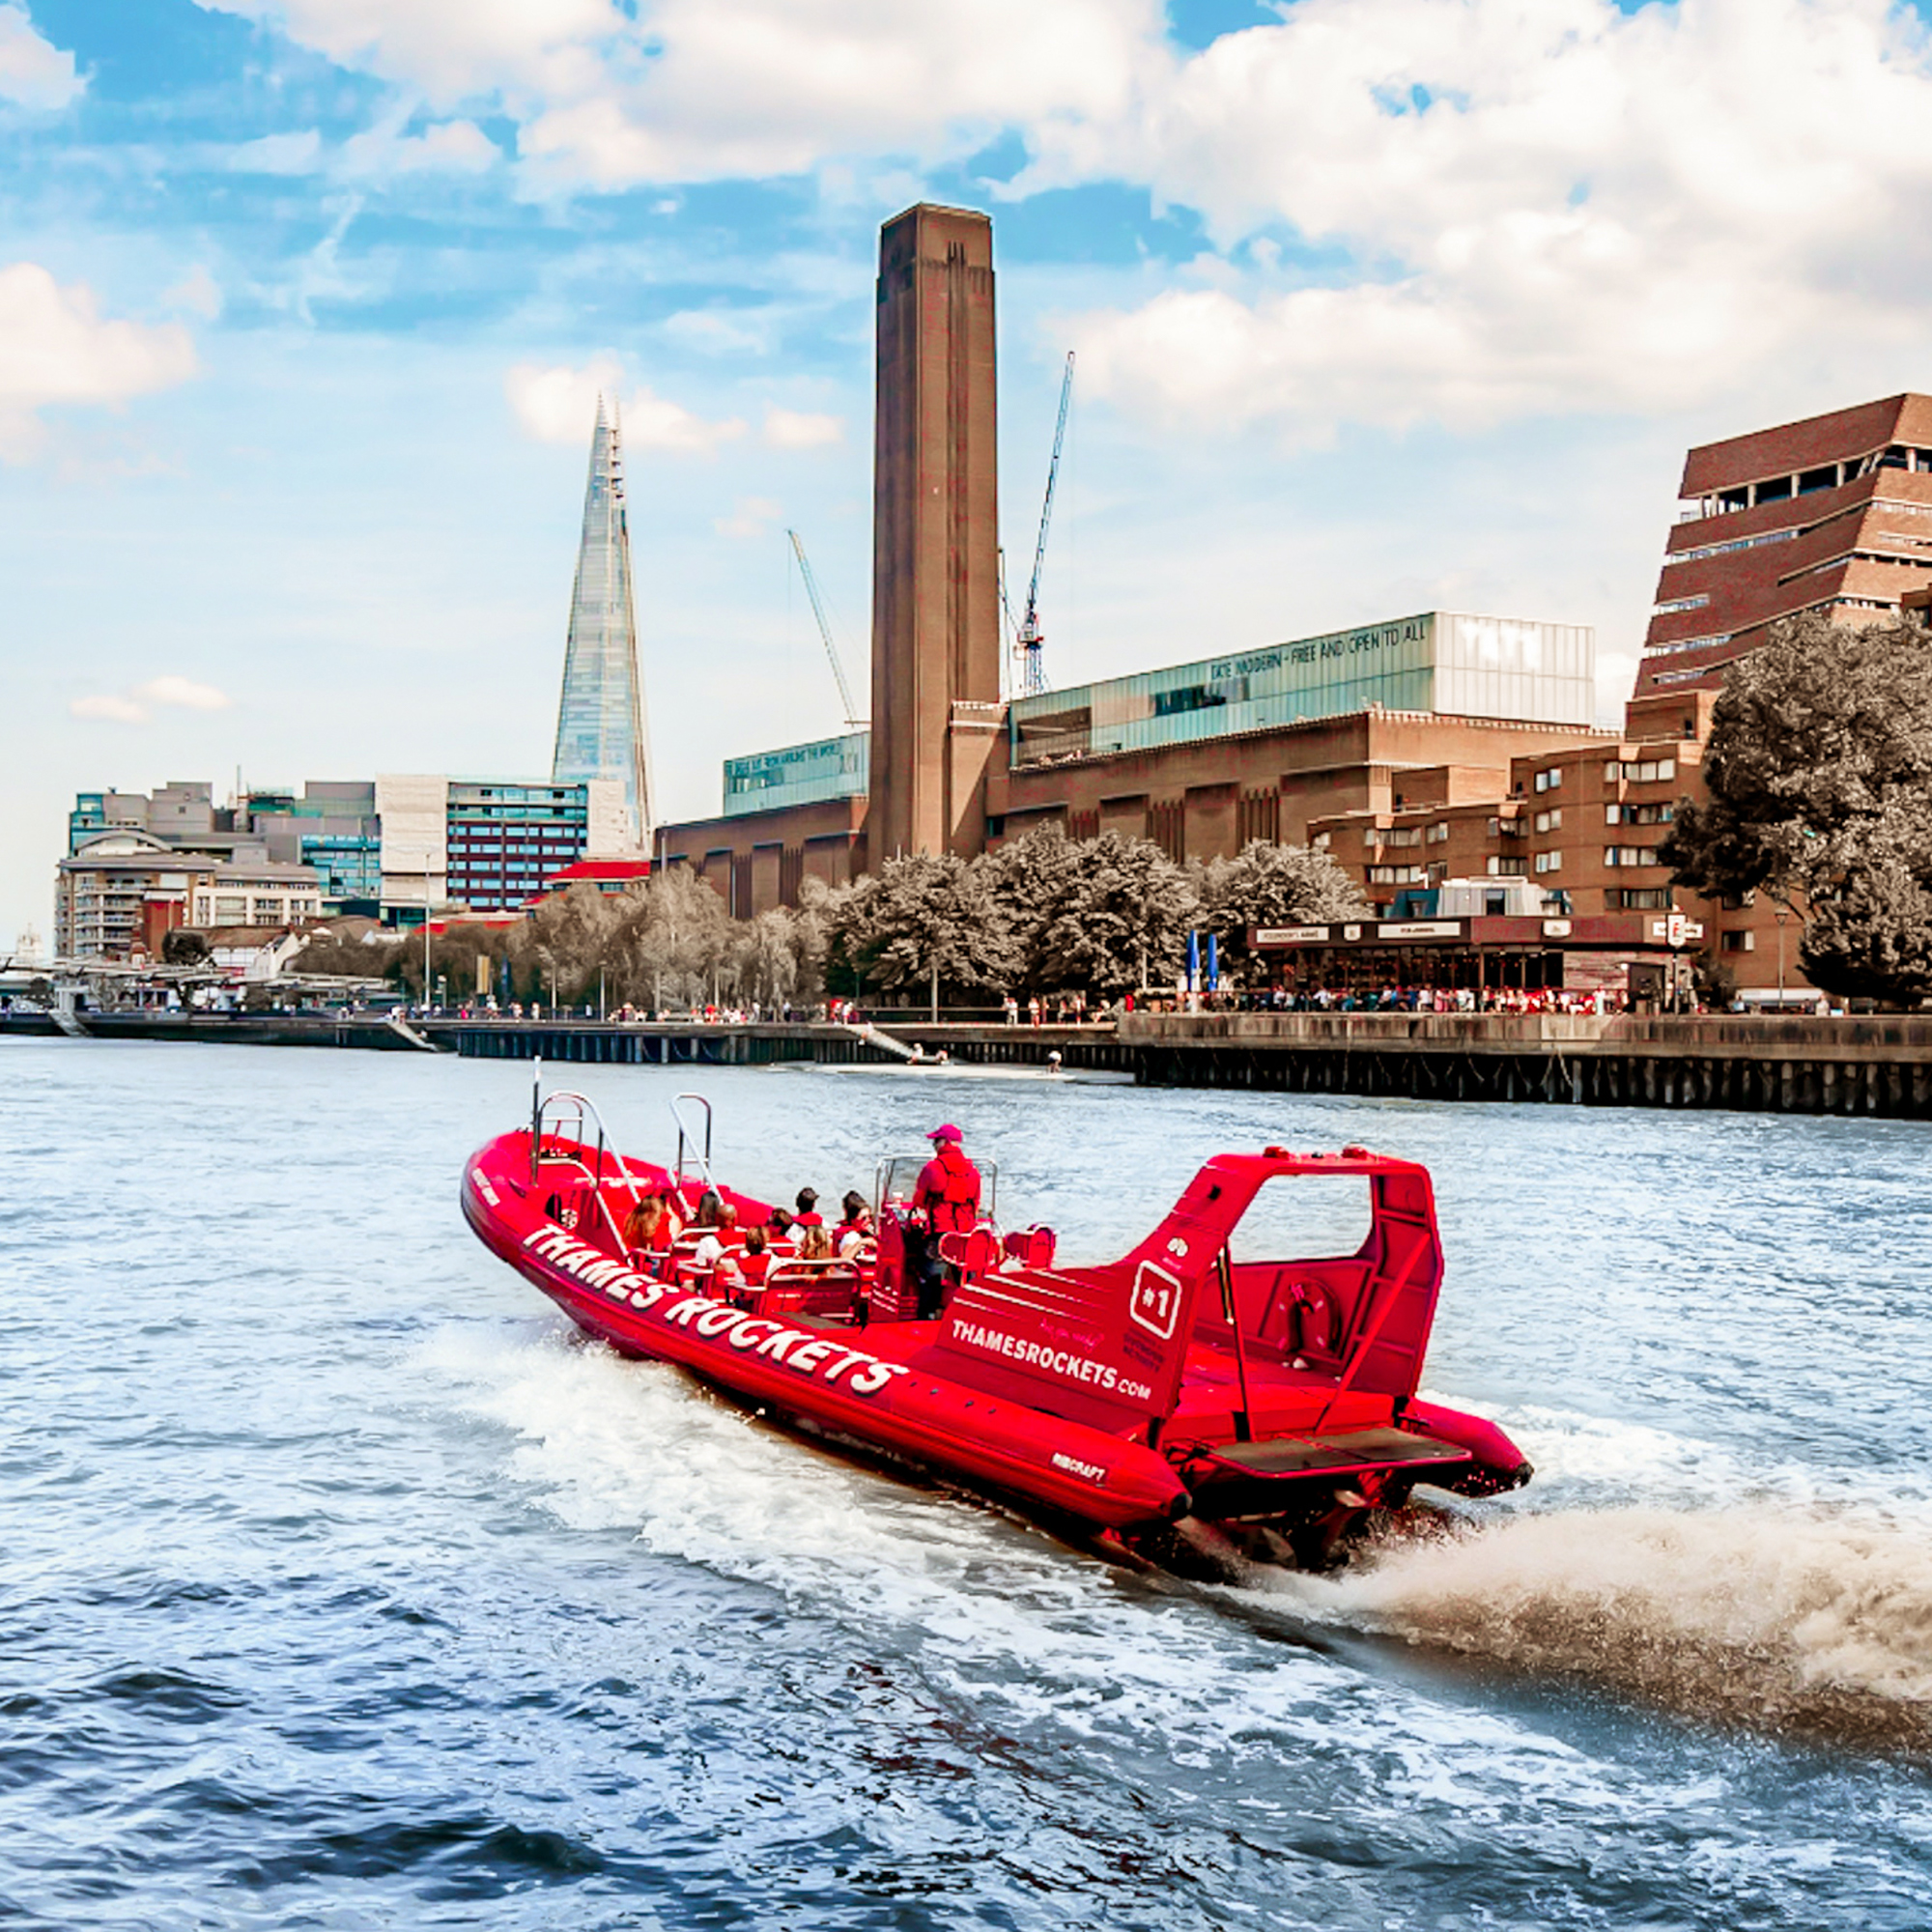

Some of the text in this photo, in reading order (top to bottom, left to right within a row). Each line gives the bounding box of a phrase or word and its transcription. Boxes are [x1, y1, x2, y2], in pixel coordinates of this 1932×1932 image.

[1320, 639, 1346, 661] AND
[1348, 631, 1380, 654] OPEN
[1384, 628, 1400, 647] TO
[1404, 620, 1426, 643] ALL
[523, 1222, 910, 1394] THAMES ROCKETS
[1141, 1286, 1170, 1318] #1
